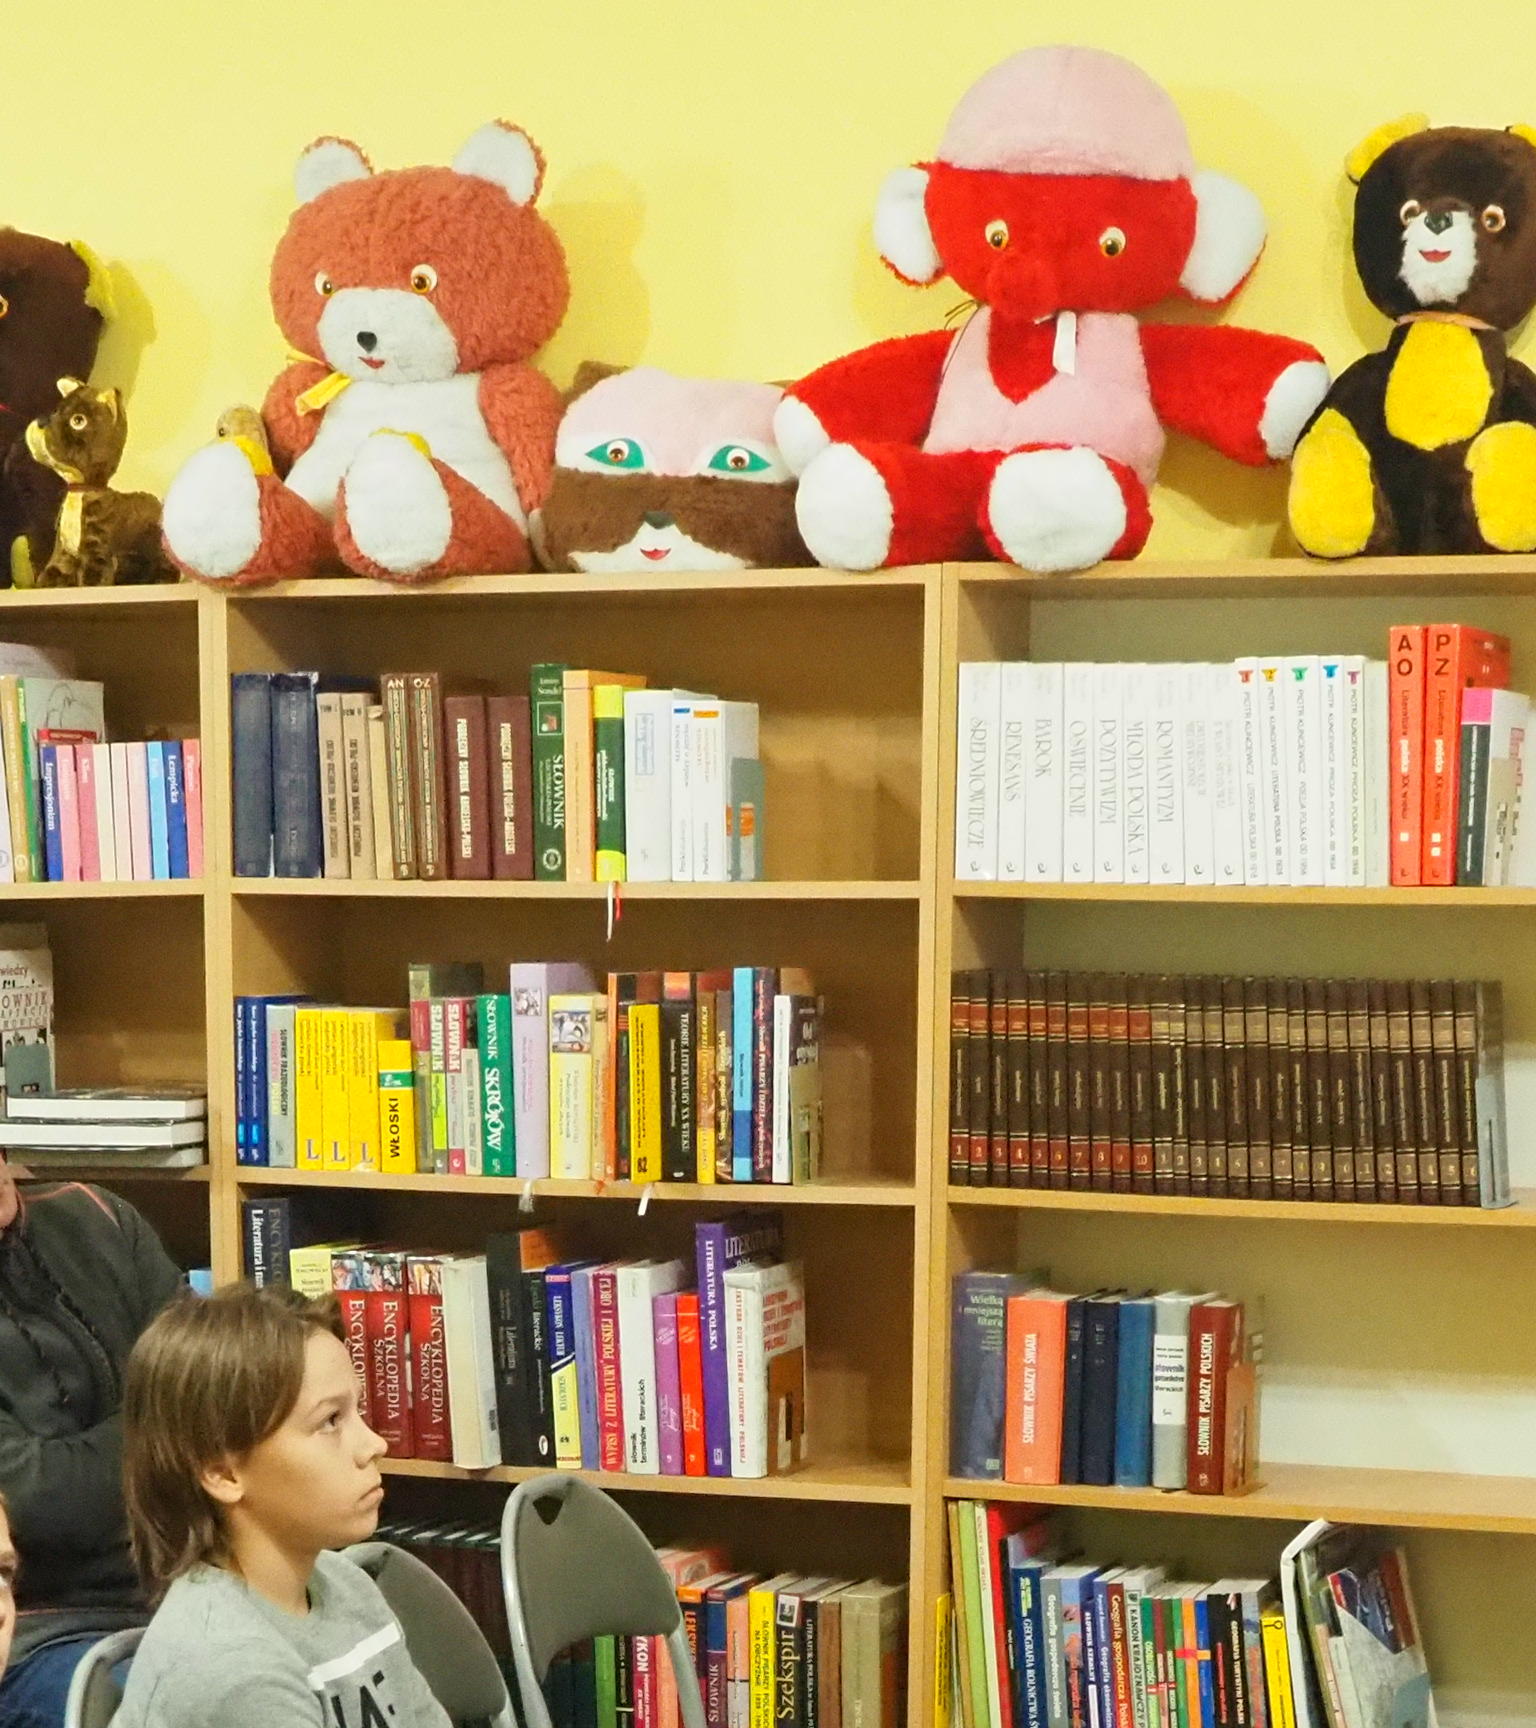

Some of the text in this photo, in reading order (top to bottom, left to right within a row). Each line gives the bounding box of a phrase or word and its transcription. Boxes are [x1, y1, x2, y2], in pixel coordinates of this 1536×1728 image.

[1395, 658, 1414, 676] O
[1396, 633, 1413, 652] A
[1432, 658, 1450, 676] Z
[1435, 633, 1452, 652] P
[1435, 689, 1447, 736] Literatura
[186, 754, 197, 791] Picasso
[1004, 720, 1023, 803] RENESANS
[1034, 718, 1053, 779] BAROK
[1099, 719, 1117, 825] POZYTYWIZM
[1155, 720, 1174, 823] ROMANTYZM
[1400, 689, 1411, 820] Literatura polska wieku
[1434, 738, 1446, 774] polska
[45, 761, 57, 831] Impresjonizm
[167, 754, 180, 804] Lempicka
[552, 754, 566, 830] SŁOWNIK
[1126, 720, 1145, 856] MŁODA POLSKA
[431, 1004, 446, 1071] SŁOWNIK
[448, 1003, 463, 1071] SŁOWNIK
[485, 999, 499, 1061] SŁOWNIK
[680, 1013, 691, 1152] TEORIE LITERATURY WIEKU
[388, 1097, 401, 1158] WŁOSKI
[251, 1208, 265, 1266] Literatura
[552, 1295, 564, 1329] LEKSYKON
[704, 1239, 718, 1351] LITERATURA POLSKA
[969, 1294, 1004, 1306] Wielką
[382, 1300, 400, 1420] ENCYKLOPEDIA
[531, 1311, 544, 1351] literackie
[373, 1338, 386, 1397] SZKOLNA
[420, 1342, 432, 1401] SZKOLNA
[429, 1304, 445, 1424] ENCYKLOPEDIA
[599, 1277, 619, 1466] WYPISY LITERATURY POLSKIEJ OBCEJ
[1021, 1333, 1037, 1444] SŁOWNIK PISARZY ŚWIATA
[1197, 1332, 1214, 1456] SŁOWNIK PISARZY POLSKICH
[630, 1432, 638, 1464] słownik
[637, 1378, 647, 1464] terminów literackich
[1022, 1618, 1034, 1668] GEOGRAFIA
[1047, 1594, 1057, 1636] Geografia
[1110, 1594, 1122, 1639] Geografia
[1129, 1608, 1139, 1642] KANON
[776, 1630, 801, 1720] Szekspir
[1084, 1611, 1095, 1681] SŁOWNIK SZKOLNY
[1099, 1646, 1110, 1683] Geografia
[1112, 1641, 1126, 1700] gospodarcza
[709, 1663, 720, 1723] SŁOWNIK
[1025, 1669, 1037, 1720] ROLNICTWA
[1132, 1644, 1145, 1720] KRAJOZNAWCZY
